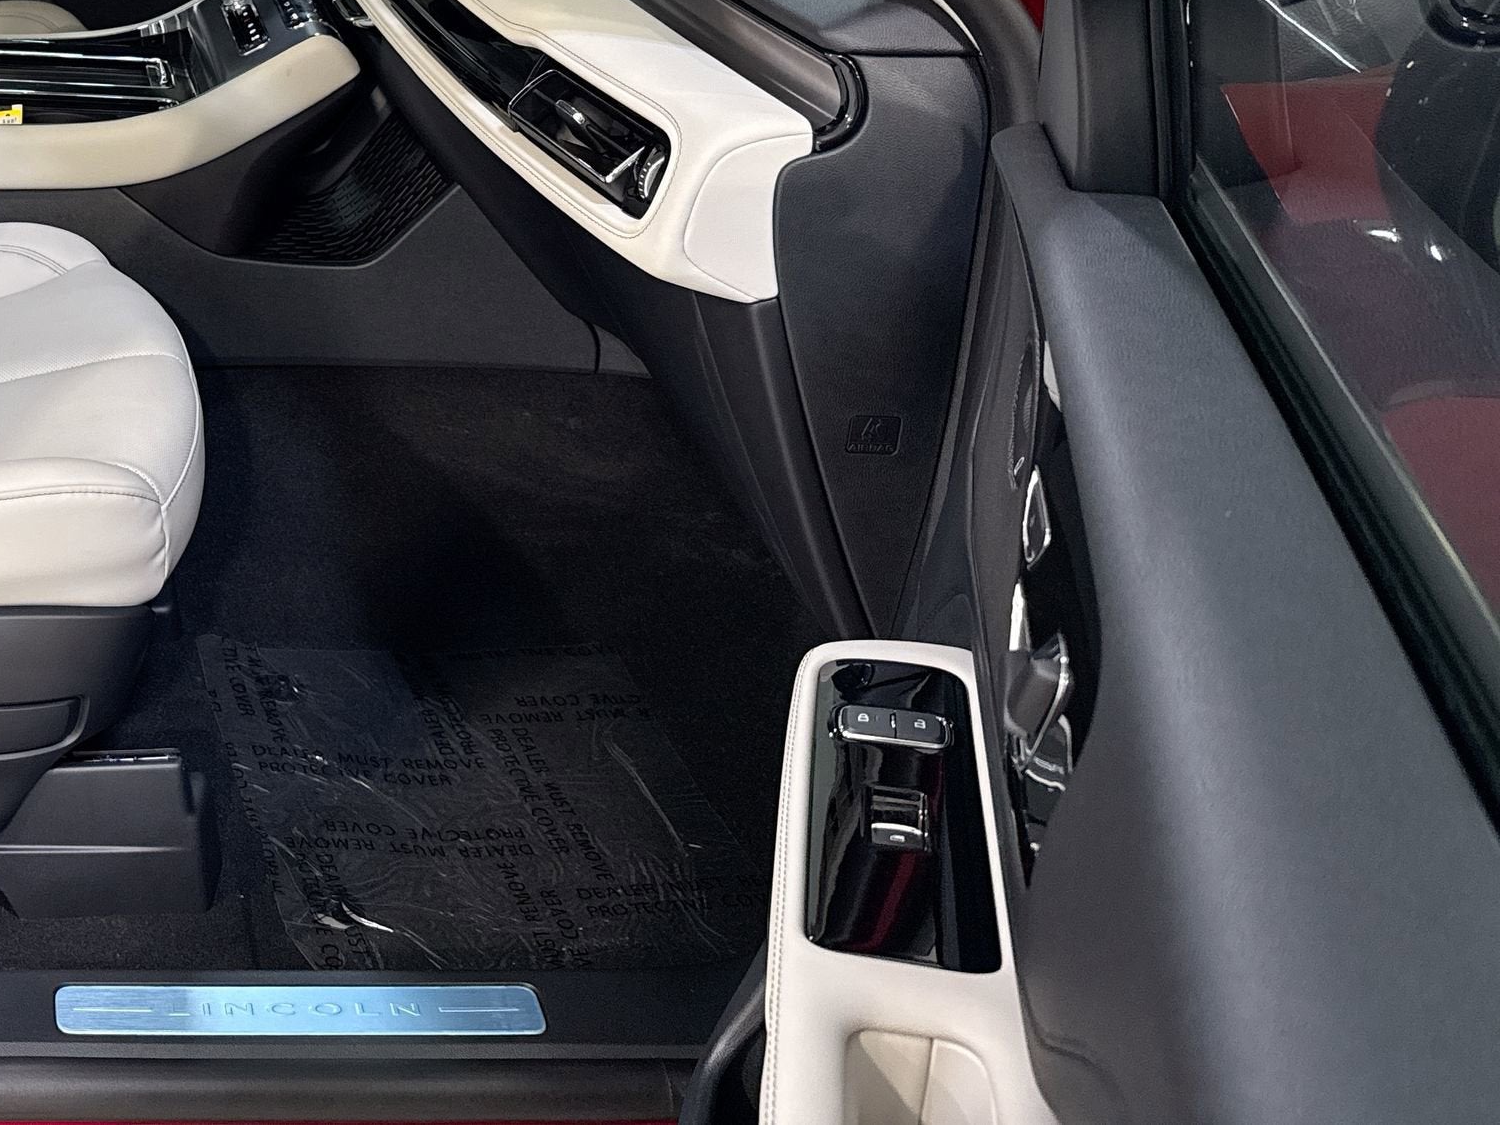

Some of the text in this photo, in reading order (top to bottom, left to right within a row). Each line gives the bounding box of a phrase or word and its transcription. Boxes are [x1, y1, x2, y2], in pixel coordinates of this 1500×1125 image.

[514, 694, 580, 707] COVER
[338, 752, 393, 769] MUST
[401, 757, 486, 771] REMOVE
[384, 773, 452, 787] COVER
[512, 727, 616, 882] DEALER MUST REMOVE
[324, 819, 396, 835] COVER
[531, 806, 570, 855] COVER
[284, 836, 376, 851] REMOVE
[389, 841, 446, 857] MUST
[496, 862, 543, 922] REMOVE
[576, 882, 658, 900] DEALER
[540, 889, 579, 940] COVER
[168, 1002, 421, 1016] LINCOLN
